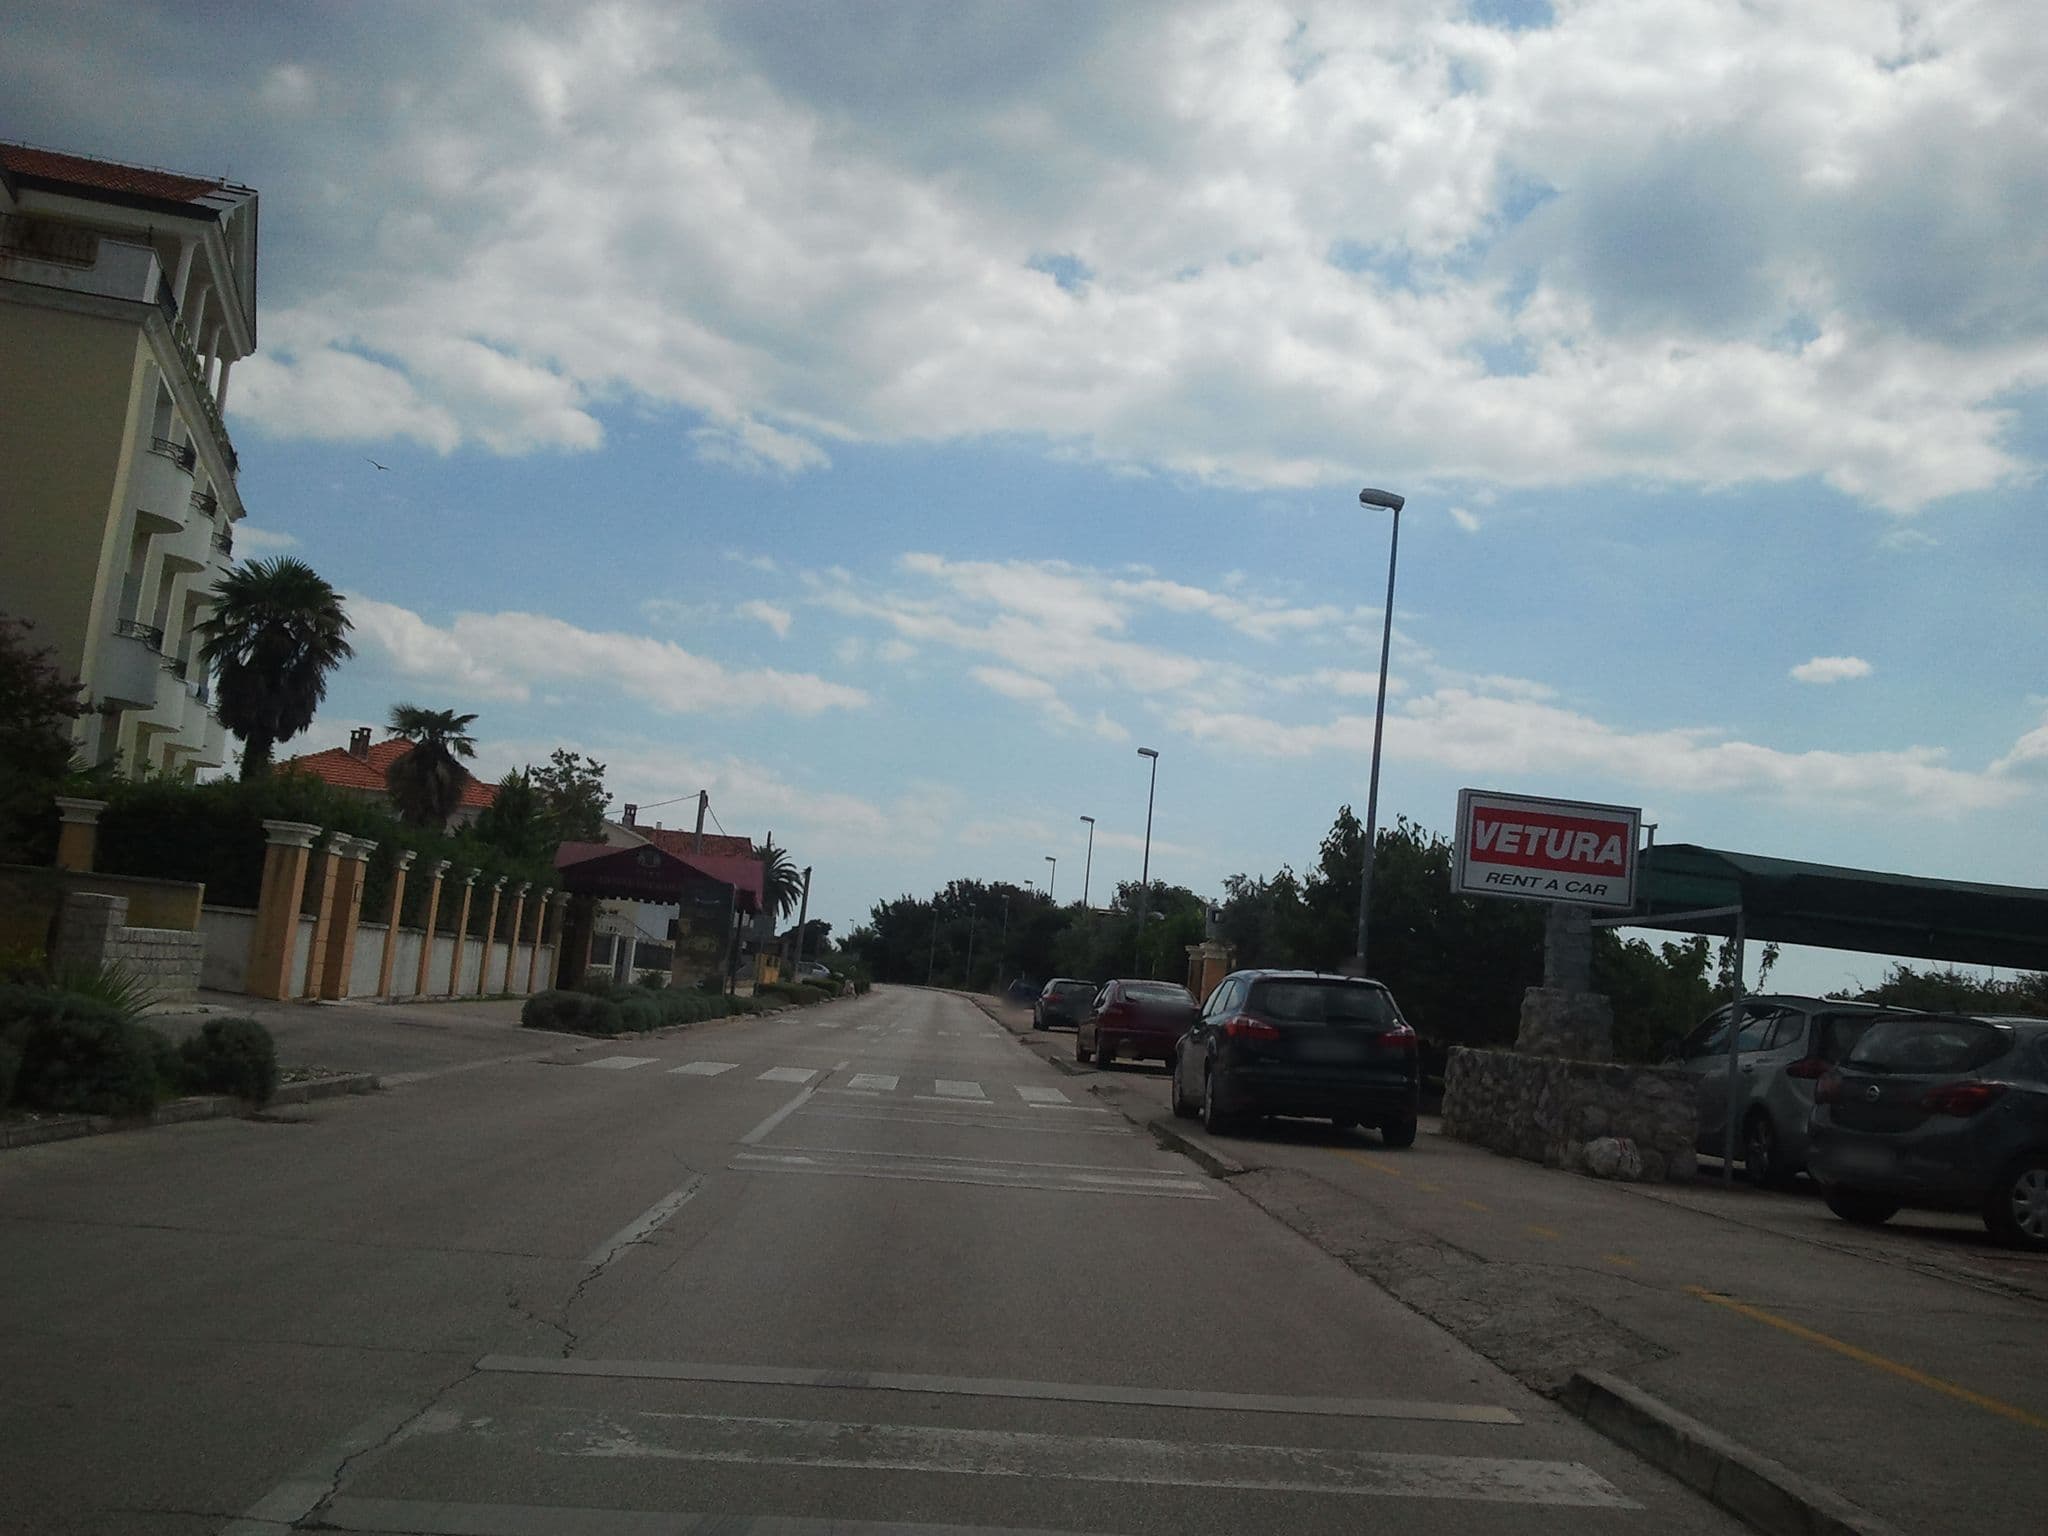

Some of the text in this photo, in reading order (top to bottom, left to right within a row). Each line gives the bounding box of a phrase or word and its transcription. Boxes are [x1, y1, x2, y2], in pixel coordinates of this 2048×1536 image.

[1475, 820, 1623, 865] VETURA
[1486, 872, 1608, 896] RENT A CAR
